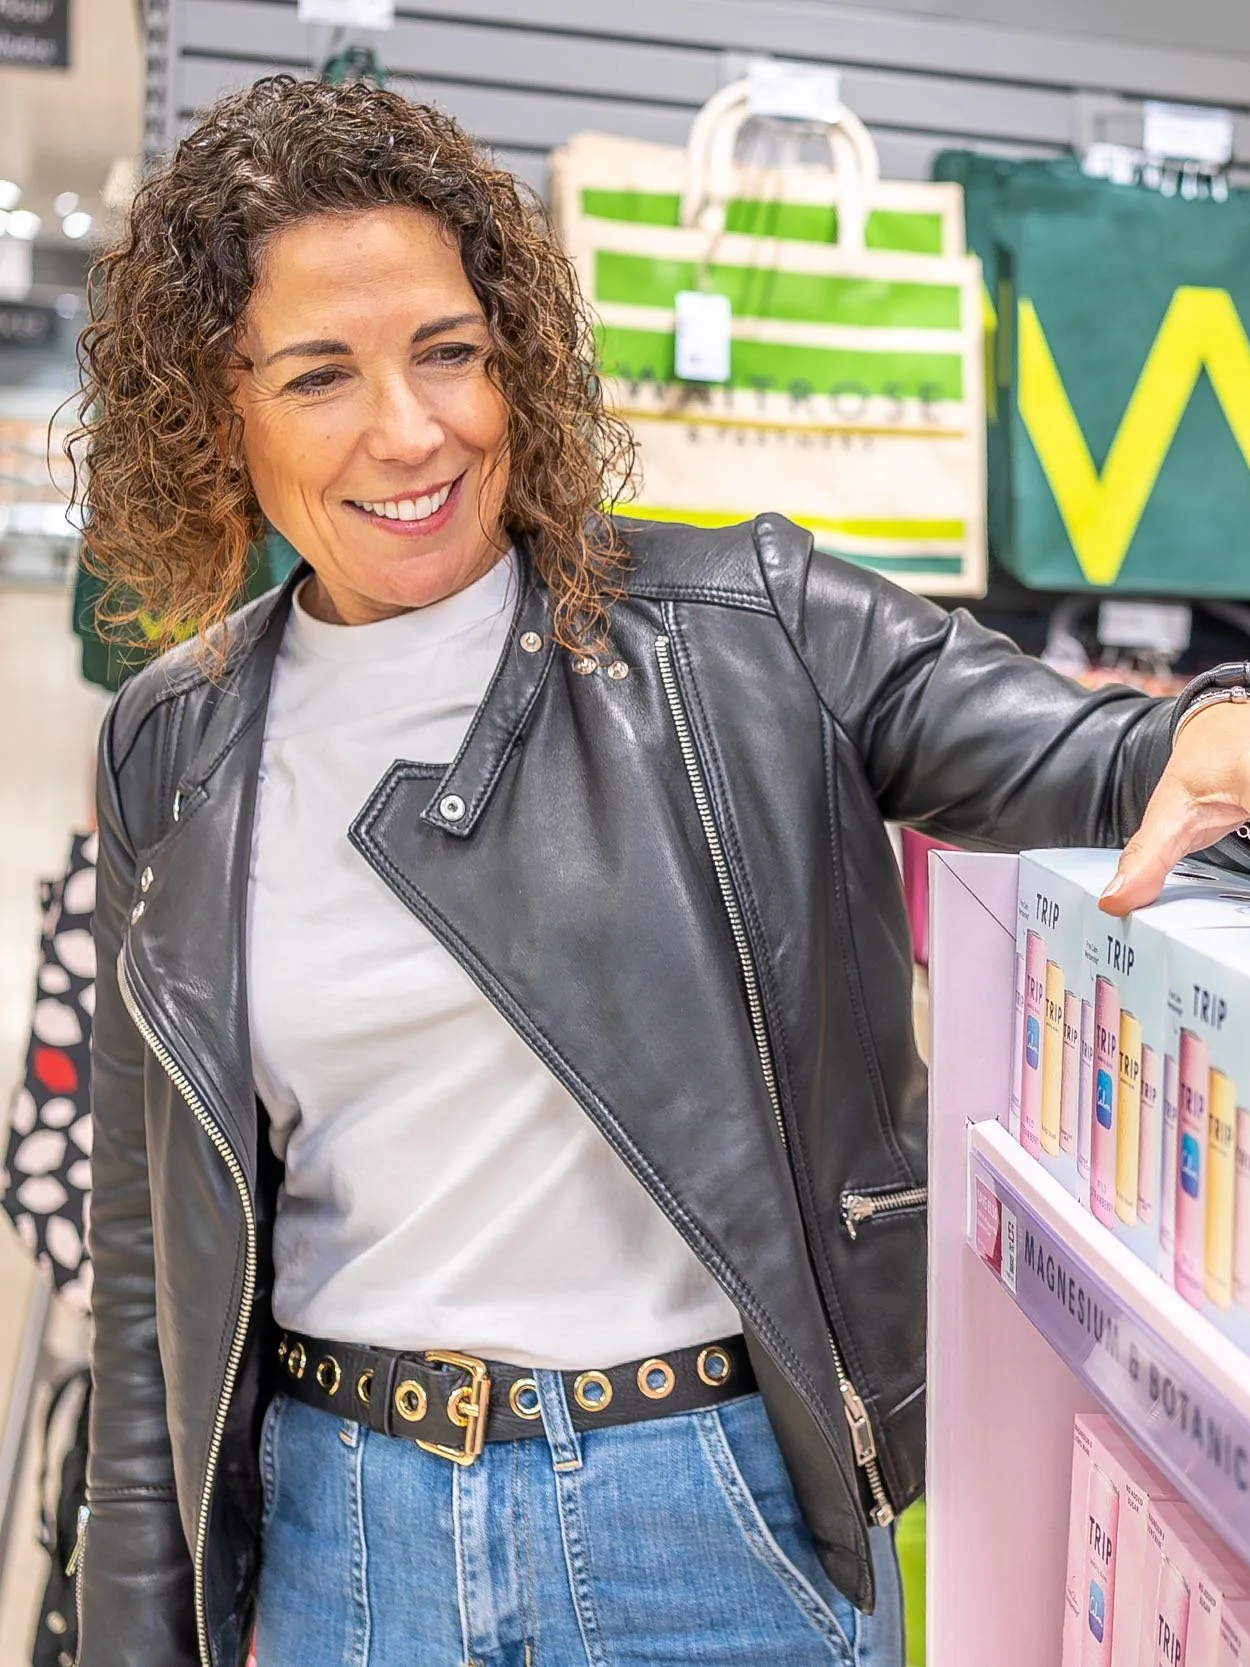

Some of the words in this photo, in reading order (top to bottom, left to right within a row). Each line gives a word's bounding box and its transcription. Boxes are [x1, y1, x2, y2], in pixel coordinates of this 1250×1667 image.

[1036, 892, 1060, 930] TRIP
[1107, 935, 1136, 976] TRIP
[1027, 974, 1043, 1005] TRIP
[1045, 998, 1063, 1025] TRIP
[1193, 984, 1228, 1031] TRIP
[1063, 1022, 1078, 1044] TRIP
[1096, 1024, 1117, 1058] TRIP
[1119, 1051, 1139, 1081] TRIP
[1140, 1079, 1157, 1101] TRIP
[1025, 1230, 1119, 1363] MAGNESIUM
[1128, 1343, 1140, 1383] &
[1127, 1497, 1139, 1513] SUGAR
[1131, 1489, 1144, 1506] ADDED
[1089, 1514, 1113, 1566] TRIP
[1158, 1612, 1182, 1667] TRIP
